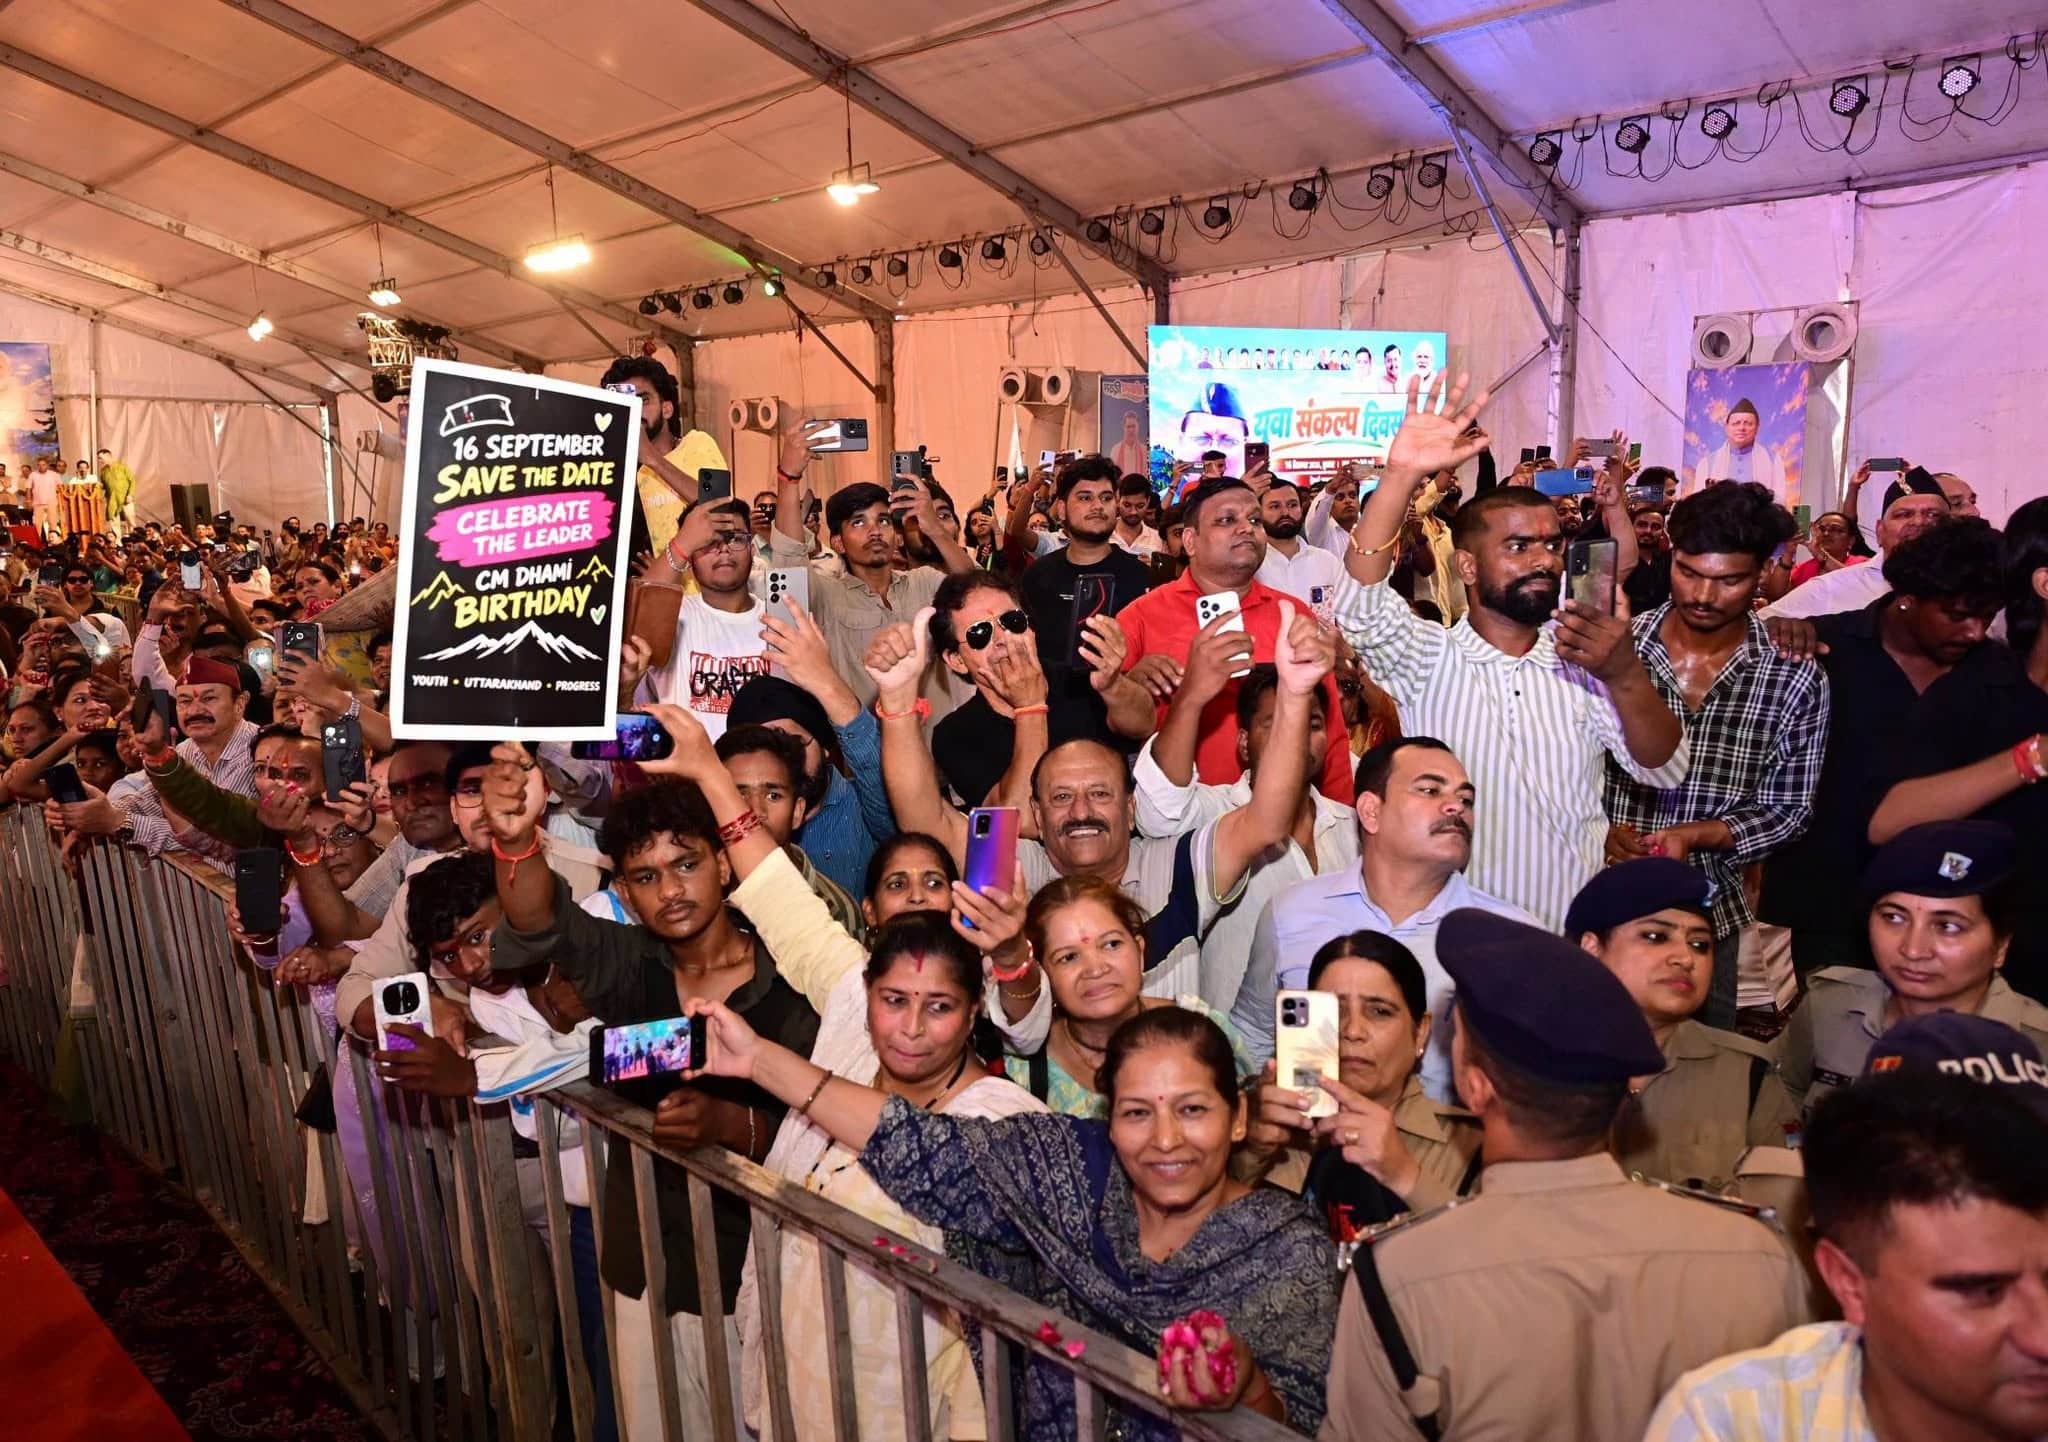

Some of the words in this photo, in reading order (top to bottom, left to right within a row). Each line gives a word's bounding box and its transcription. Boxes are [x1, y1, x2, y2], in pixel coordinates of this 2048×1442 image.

[1254, 406, 1293, 443] युवा
[1296, 397, 1360, 438] संकल्प
[453, 435, 479, 461] 16
[485, 433, 604, 460] SEPTEMBER
[433, 463, 517, 504] SAVE
[522, 466, 558, 488] THE
[562, 461, 615, 487] DATE
[457, 500, 592, 535] CELEBRATE
[472, 533, 517, 556] THE
[523, 523, 593, 549] LEADER
[475, 568, 510, 592] CM
[454, 584, 592, 629] BIRTHDAY
[412, 674, 448, 687] YOUTH
[464, 677, 542, 691] UTTARAKHAND
[555, 680, 600, 691] PROGRESS
[1937, 1052, 2048, 1088] POLIC
